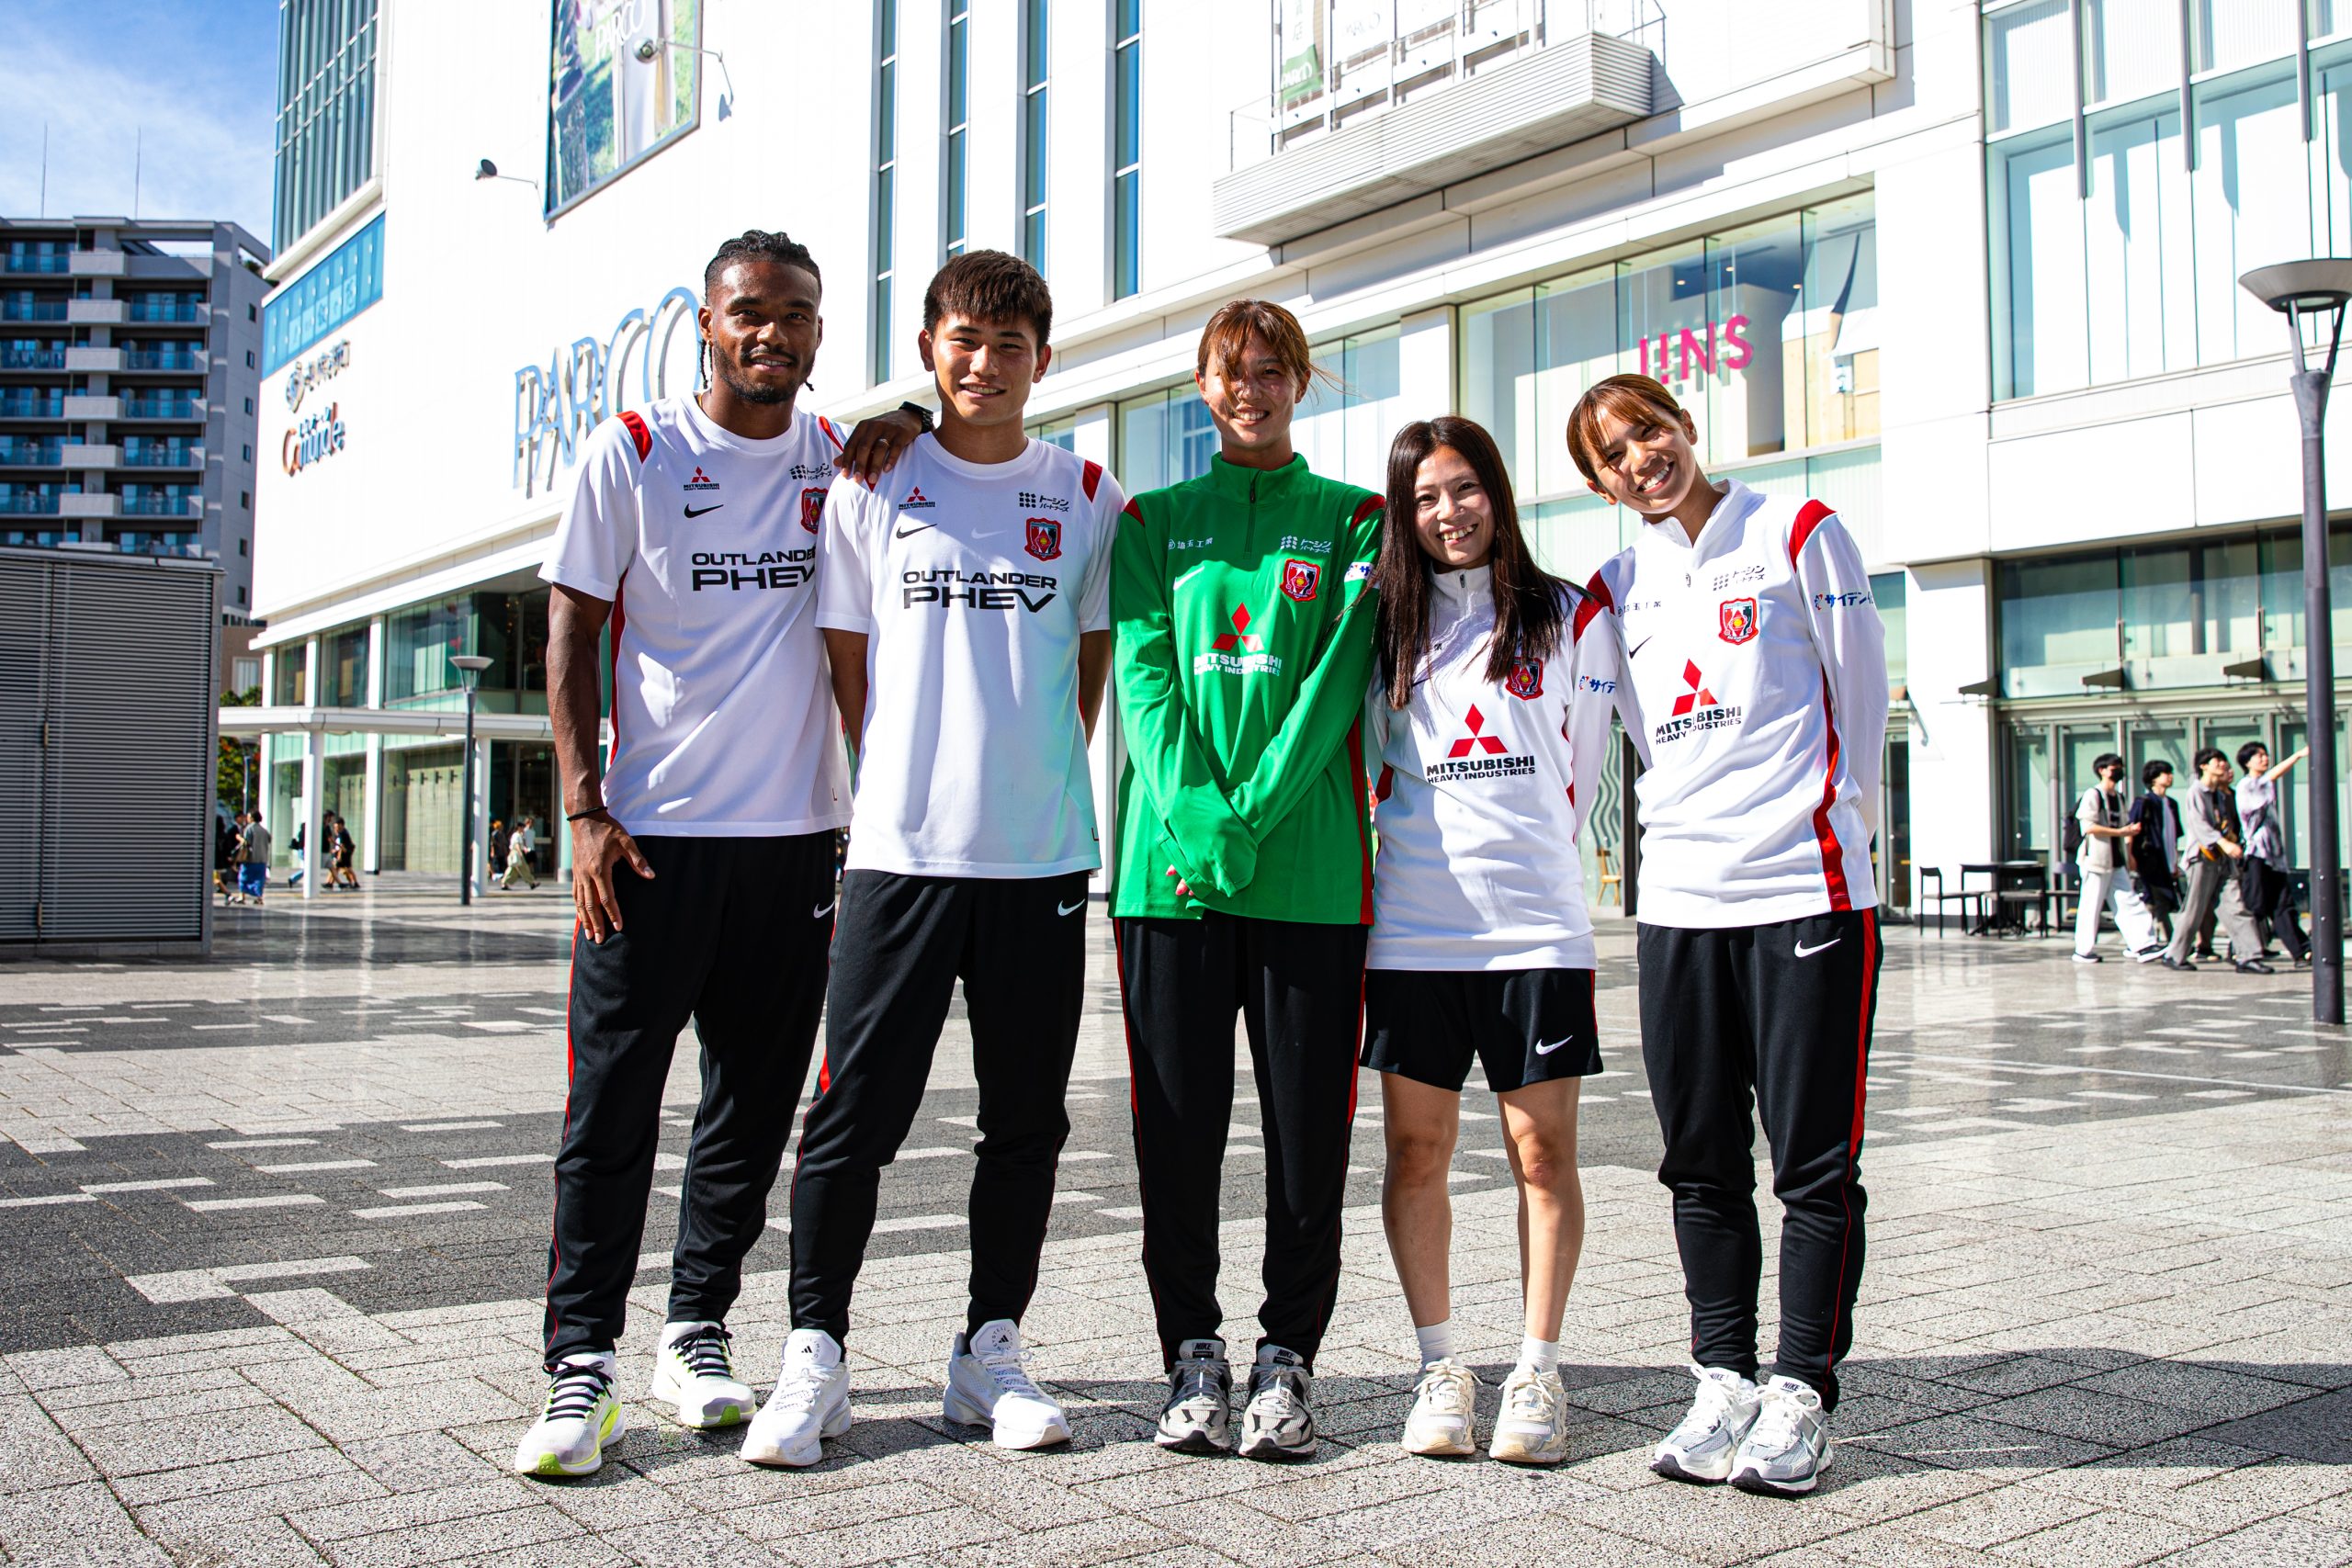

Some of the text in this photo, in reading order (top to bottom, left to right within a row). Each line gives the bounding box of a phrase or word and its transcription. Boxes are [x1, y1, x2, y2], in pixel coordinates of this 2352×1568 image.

[513, 286, 702, 490] PARCO
[1039, 494, 1069, 506] トーシン
[1300, 538, 1332, 548] トーシン
[692, 565, 816, 592] PHEV
[903, 570, 1057, 591] OUTLANDER
[1732, 565, 1765, 579] トーシン
[903, 586, 1057, 614] PHEV
[1656, 705, 1742, 738] MITSBISHI
[1656, 730, 1687, 746] HEAVY
[1427, 755, 1535, 776] MITSUBISHI
[1428, 766, 1536, 784] HEAVY INDUSTRIES
[1194, 1342, 1212, 1350] NIKE
[1277, 1348, 1295, 1359] NIKE
[1782, 1381, 1800, 1392] NIKE
